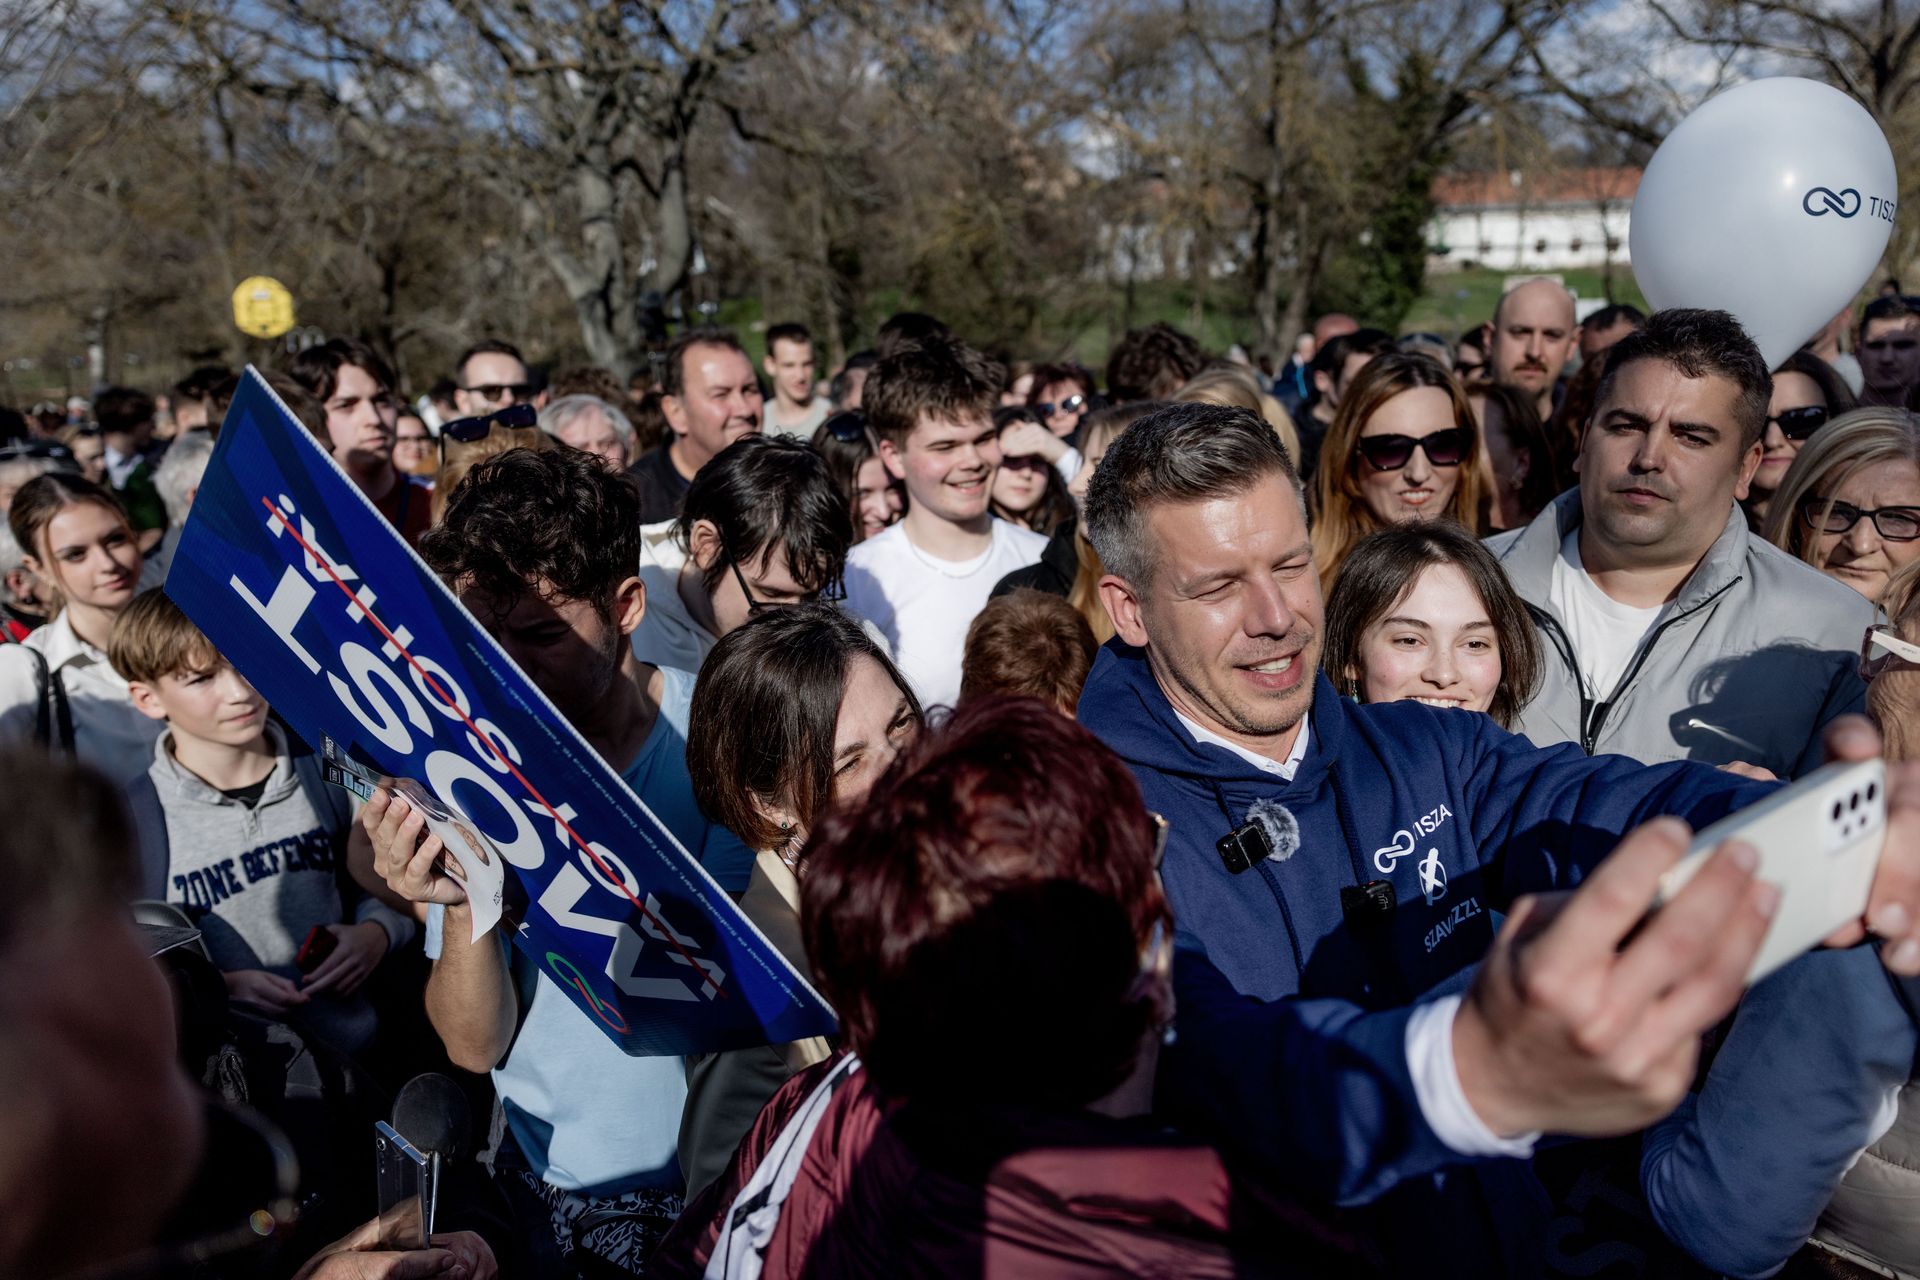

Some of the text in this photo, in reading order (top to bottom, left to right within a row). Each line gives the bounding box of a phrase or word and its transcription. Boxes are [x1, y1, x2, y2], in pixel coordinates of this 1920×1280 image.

[229, 564, 699, 1001] MOST
[265, 493, 726, 1000] VAGY SOHA!
[174, 859, 244, 915] ZONE
[1424, 896, 1482, 953] SZAVZZ!
